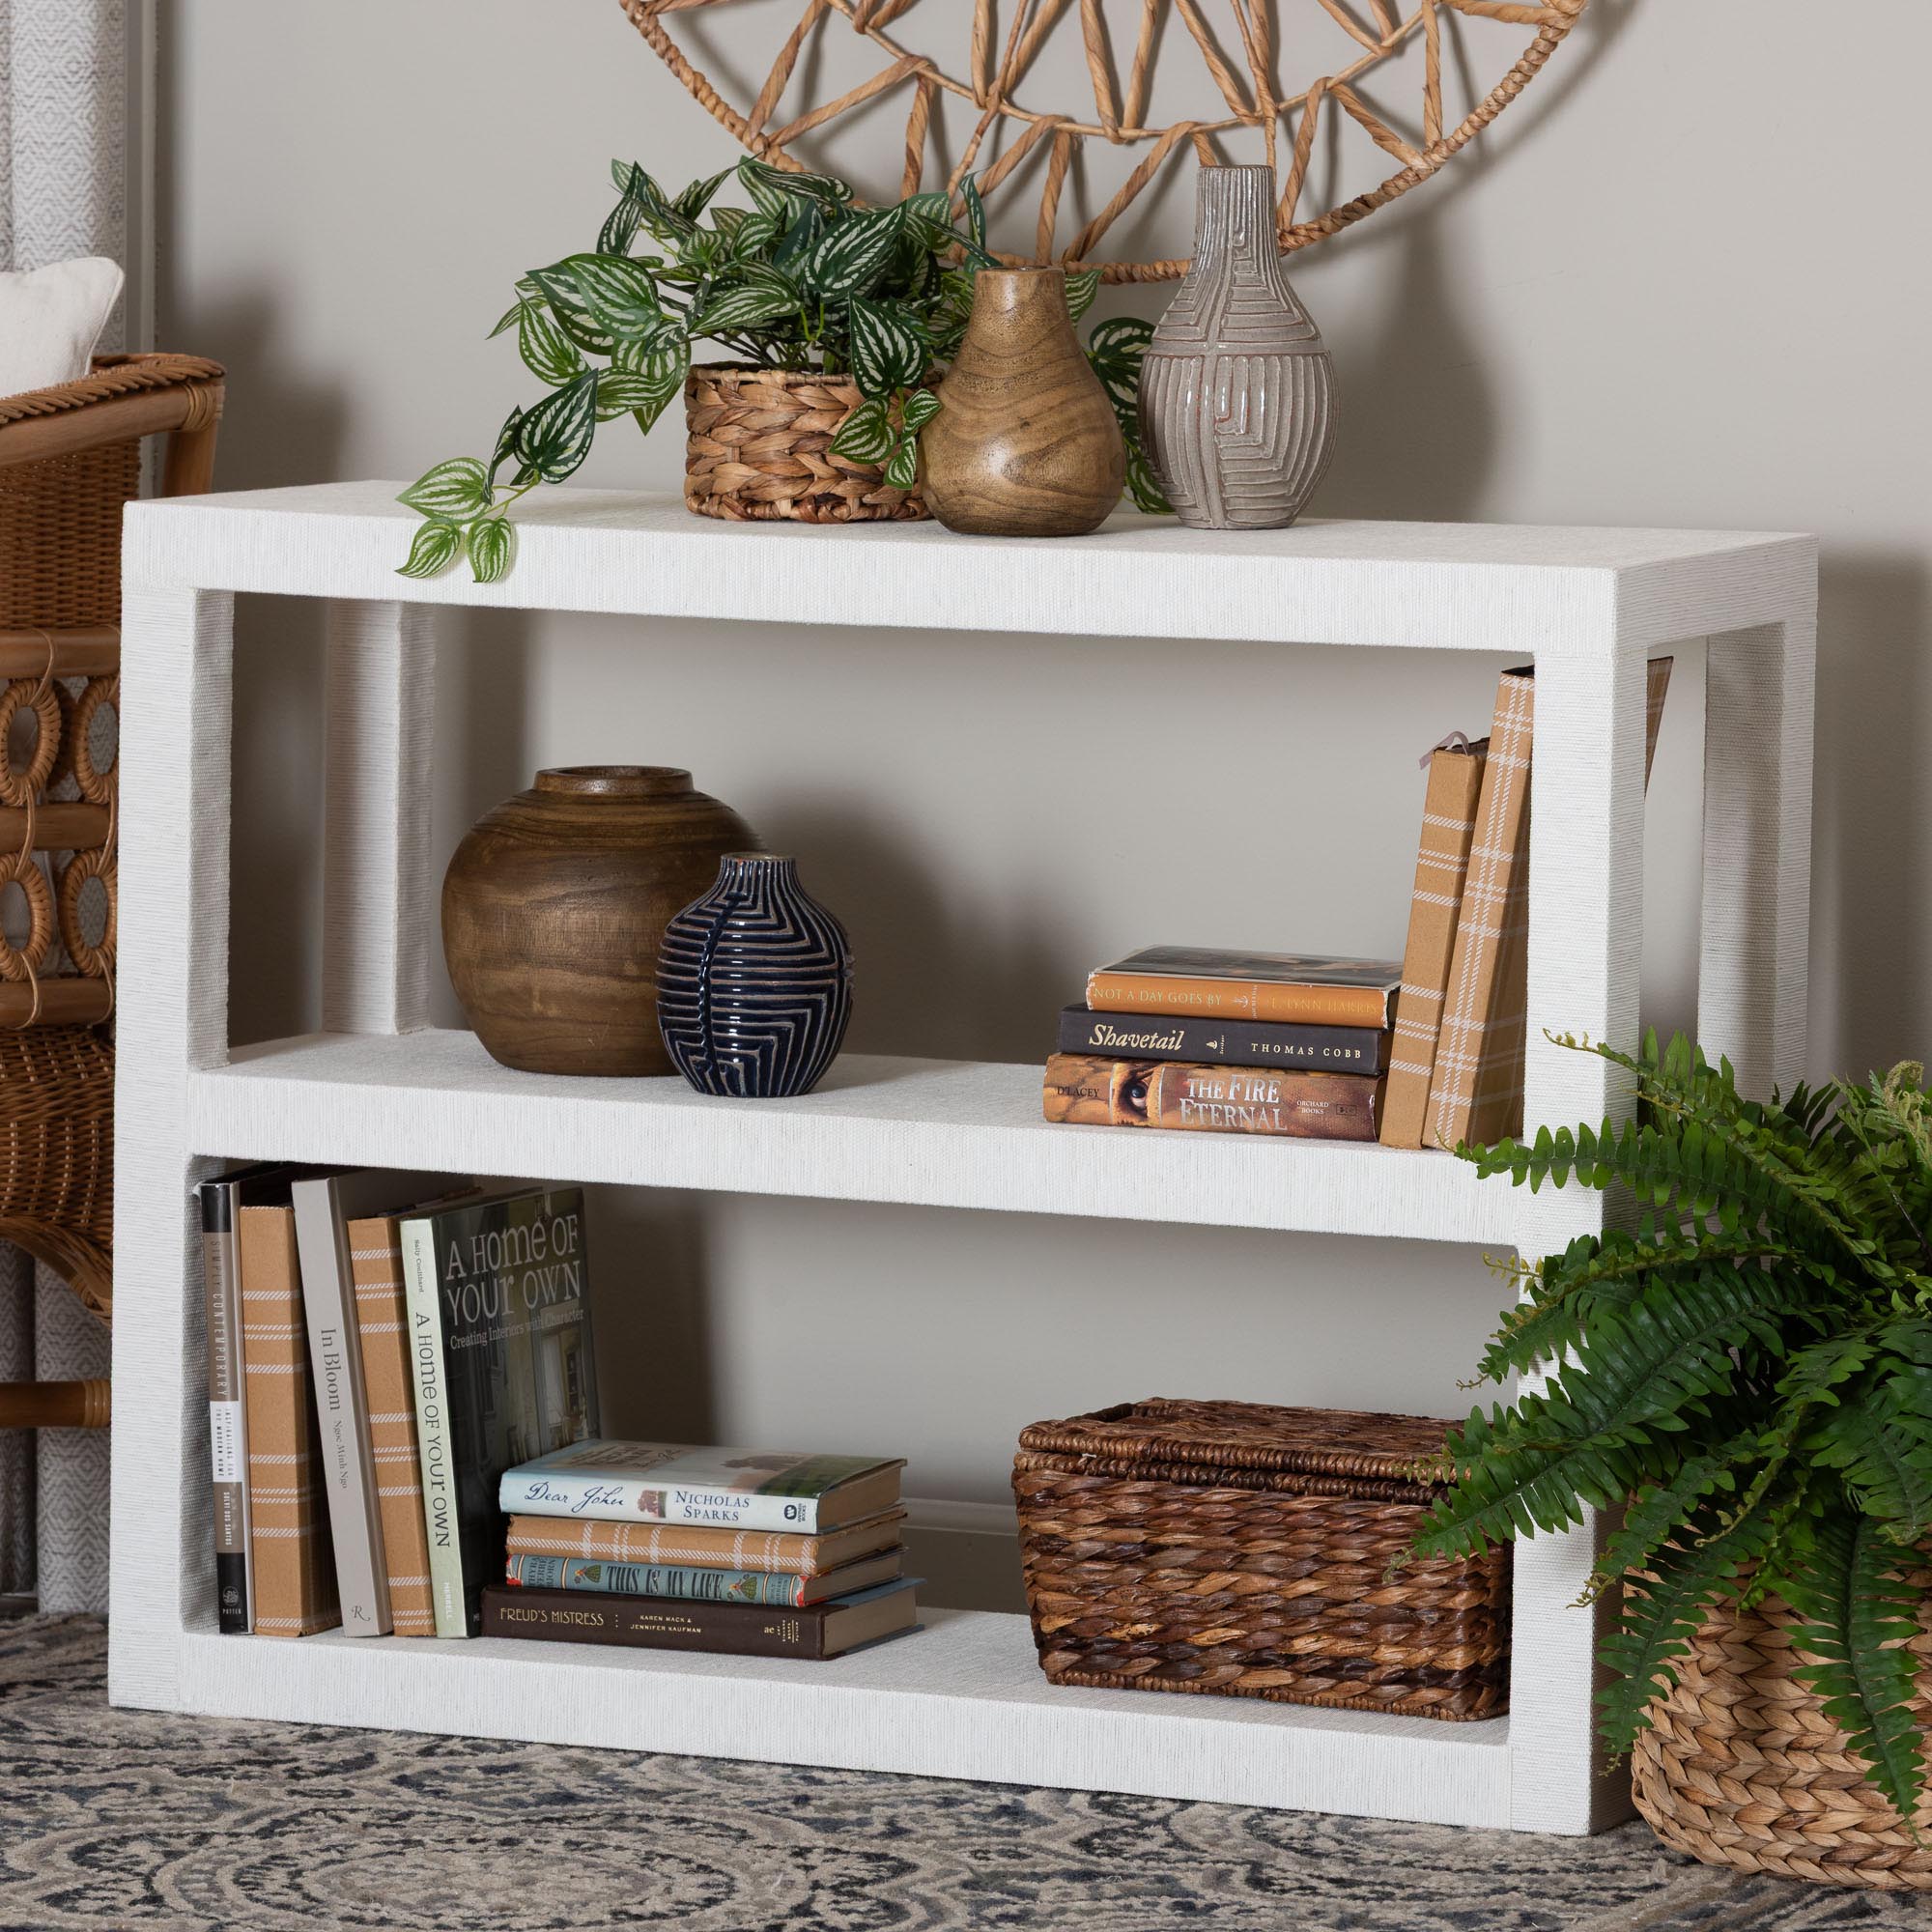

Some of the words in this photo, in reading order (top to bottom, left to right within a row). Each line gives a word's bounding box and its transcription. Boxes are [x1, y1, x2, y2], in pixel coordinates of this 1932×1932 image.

[1094, 987, 1123, 1001] NOT
[1126, 989, 1135, 1001] A
[1139, 990, 1165, 1003] DAY
[1168, 991, 1203, 1005] GOES
[1207, 993, 1222, 1006] BY
[1327, 999, 1378, 1013] HARRIS
[1089, 1024, 1185, 1050] Shavetail
[1251, 1043, 1314, 1056] THOMAS
[1322, 1047, 1361, 1059] COBB
[1057, 1086, 1100, 1098] D'LACEY
[1187, 1078, 1226, 1098] THE
[1228, 1074, 1282, 1104] FIRE
[1179, 1097, 1288, 1131] ETERNAL
[1296, 1099, 1329, 1108] ORCHARD
[445, 1240, 468, 1281] A
[552, 1214, 579, 1257] OF
[211, 1240, 222, 1286] SIMPLY
[523, 1260, 582, 1310] OWN
[321, 1328, 337, 1348] In
[450, 1330, 488, 1350] Creating
[488, 1322, 525, 1341] Interiors
[541, 1308, 584, 1328] Character
[213, 1293, 230, 1397] CONTEMPORARY
[324, 1352, 342, 1410] Bloom
[333, 1419, 343, 1443] Ngoc
[415, 1312, 431, 1328] A
[424, 1405, 440, 1430] OF
[433, 1496, 450, 1548] OWN
[336, 1444, 348, 1469] Minh
[339, 1470, 349, 1490] Ngo
[524, 1481, 569, 1504] Dear
[571, 1486, 624, 1513] John
[675, 1491, 751, 1508] NICHOLAS
[683, 1505, 739, 1521] SPARKS
[607, 1565, 640, 1593] THIS
[645, 1568, 661, 1595] IS
[666, 1570, 688, 1596] MY
[692, 1572, 724, 1600] LIFE
[352, 1605, 371, 1621] R
[499, 1607, 548, 1623] FREUD'S
[552, 1610, 604, 1626] MISTRESS
